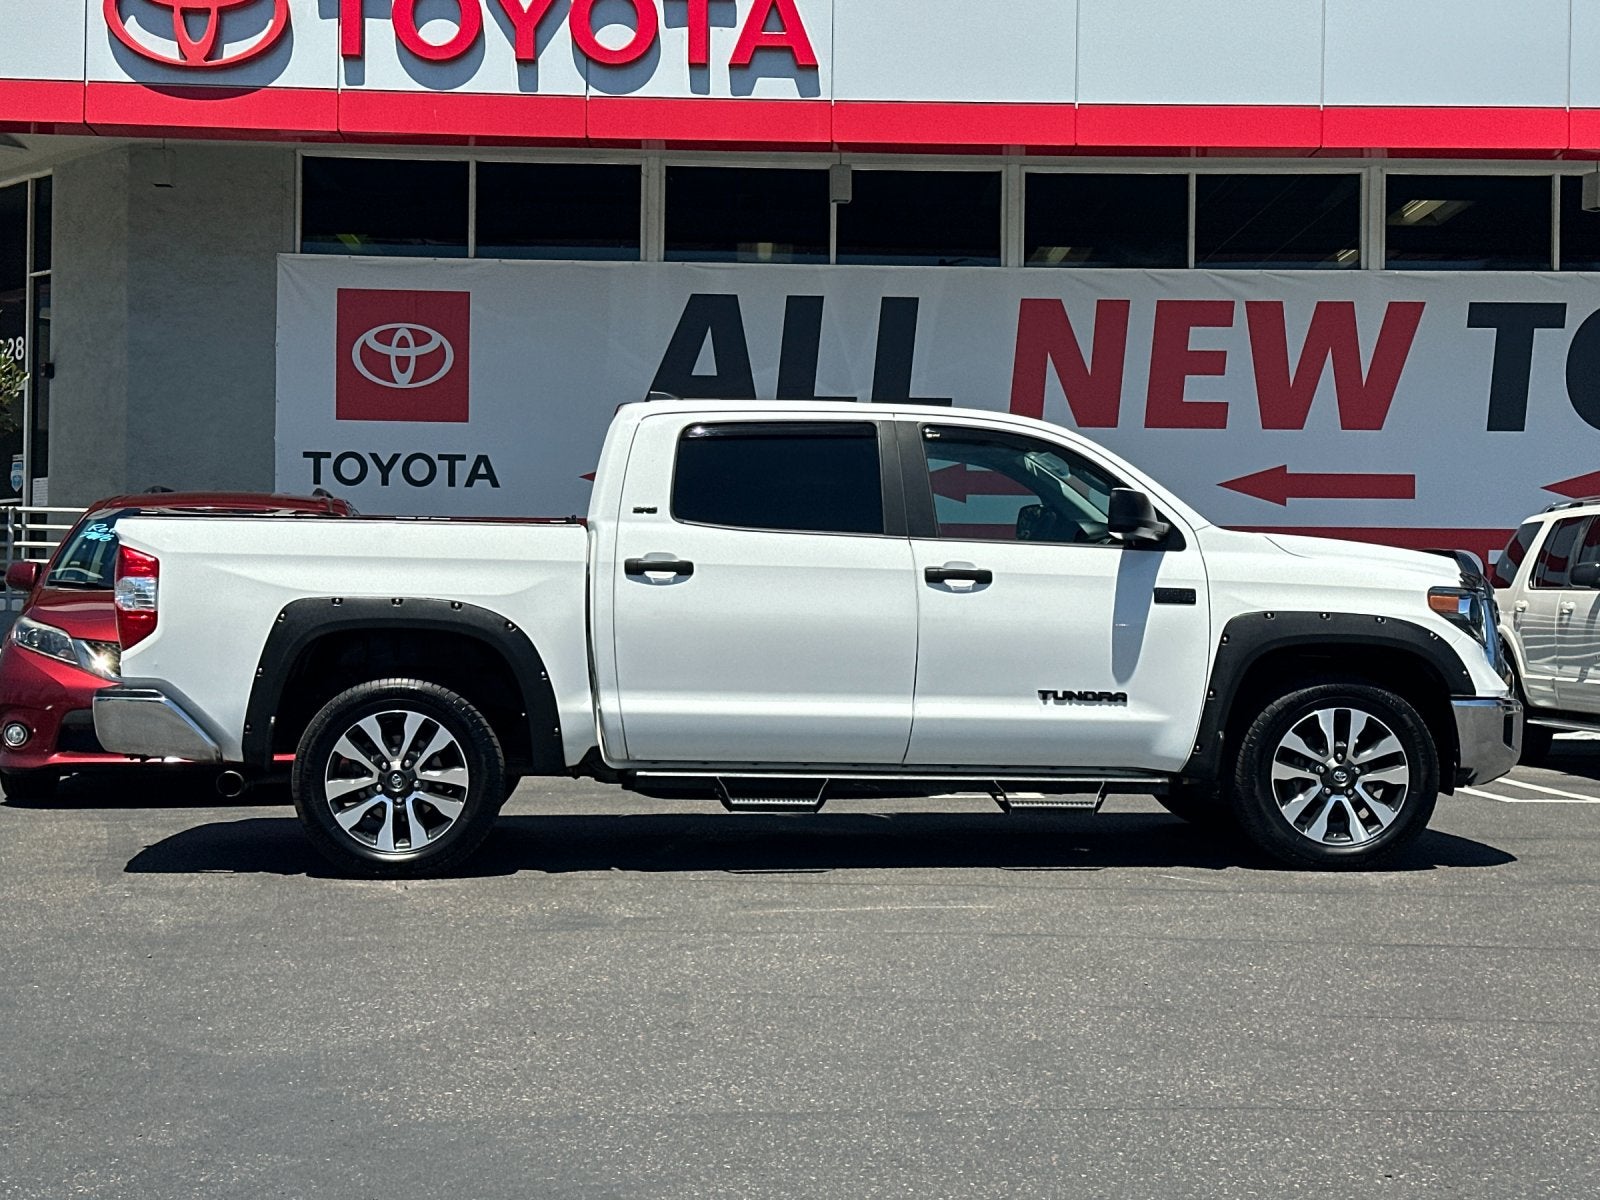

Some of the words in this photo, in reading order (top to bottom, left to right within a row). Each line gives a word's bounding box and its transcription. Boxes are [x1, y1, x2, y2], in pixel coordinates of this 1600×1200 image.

[0, 336, 24, 360] 28
[645, 293, 953, 407] ALL
[1009, 298, 1426, 430] NEW
[1467, 302, 1600, 431] T
[302, 451, 501, 488] TOYOTA
[1037, 689, 1128, 704] TUNDRA
